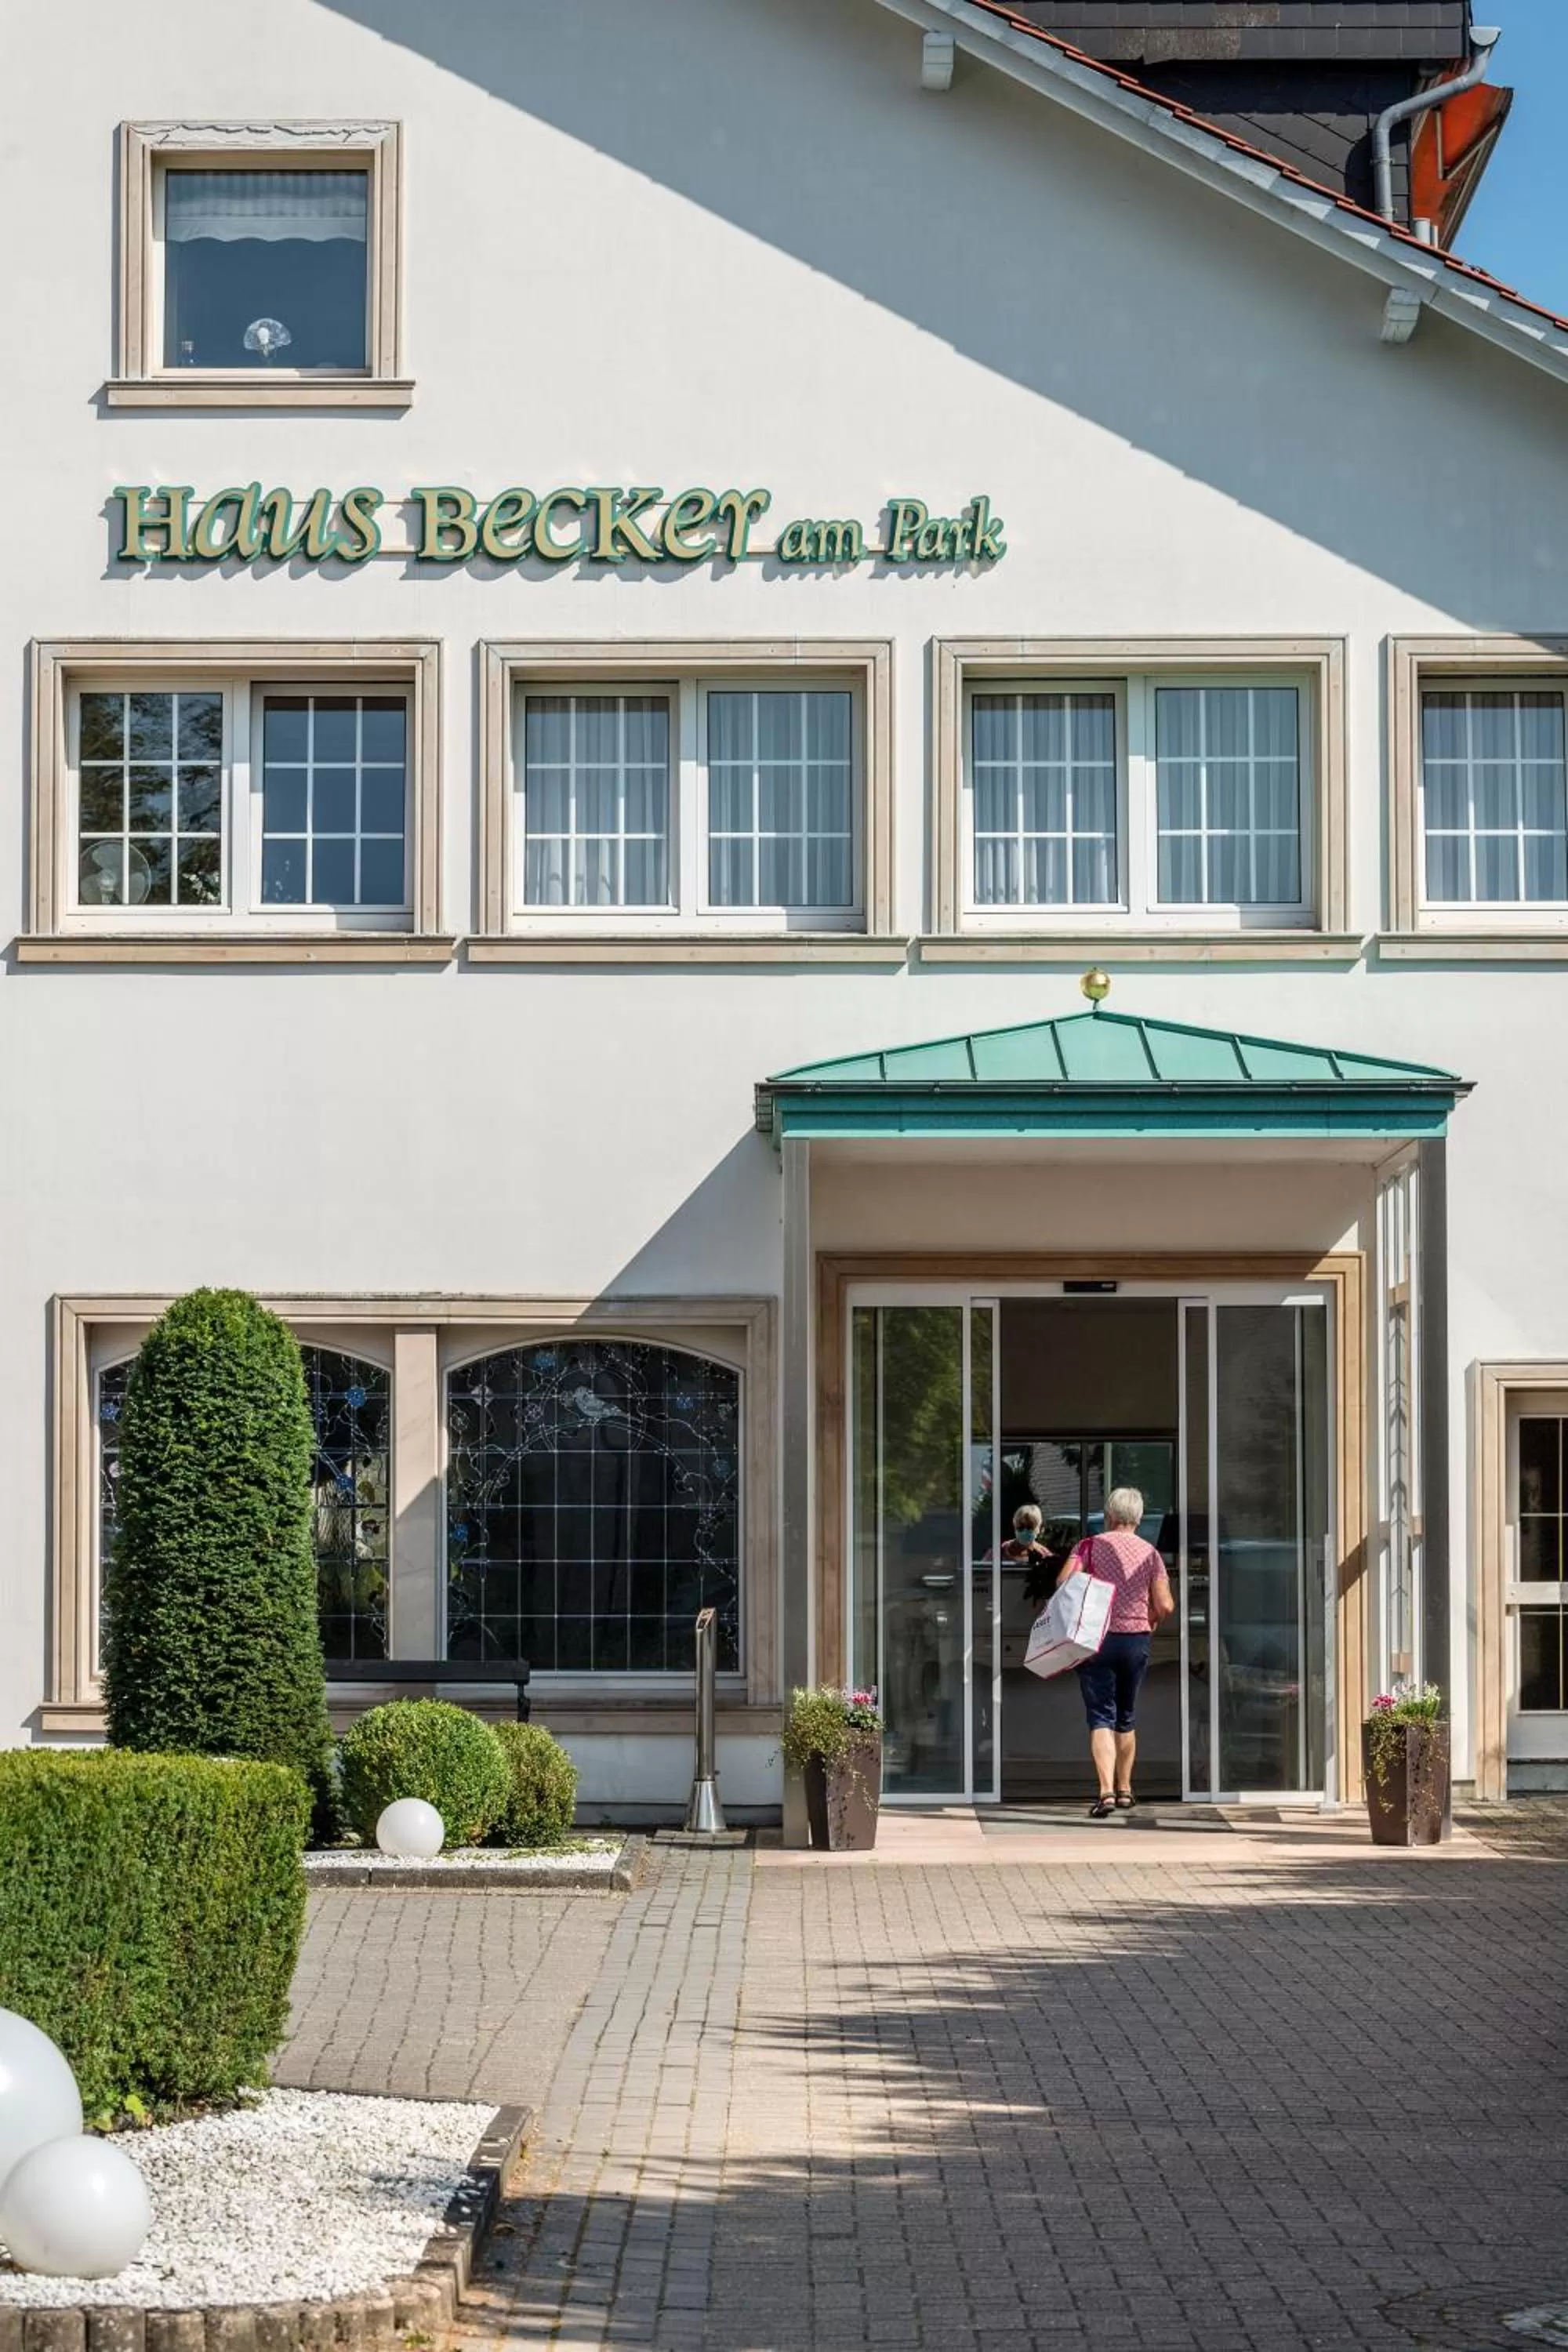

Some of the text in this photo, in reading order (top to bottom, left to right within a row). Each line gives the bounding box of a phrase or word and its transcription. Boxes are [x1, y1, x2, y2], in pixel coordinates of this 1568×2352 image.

[114, 481, 383, 562] Haus
[777, 517, 866, 563] am
[884, 495, 1006, 562] Park
